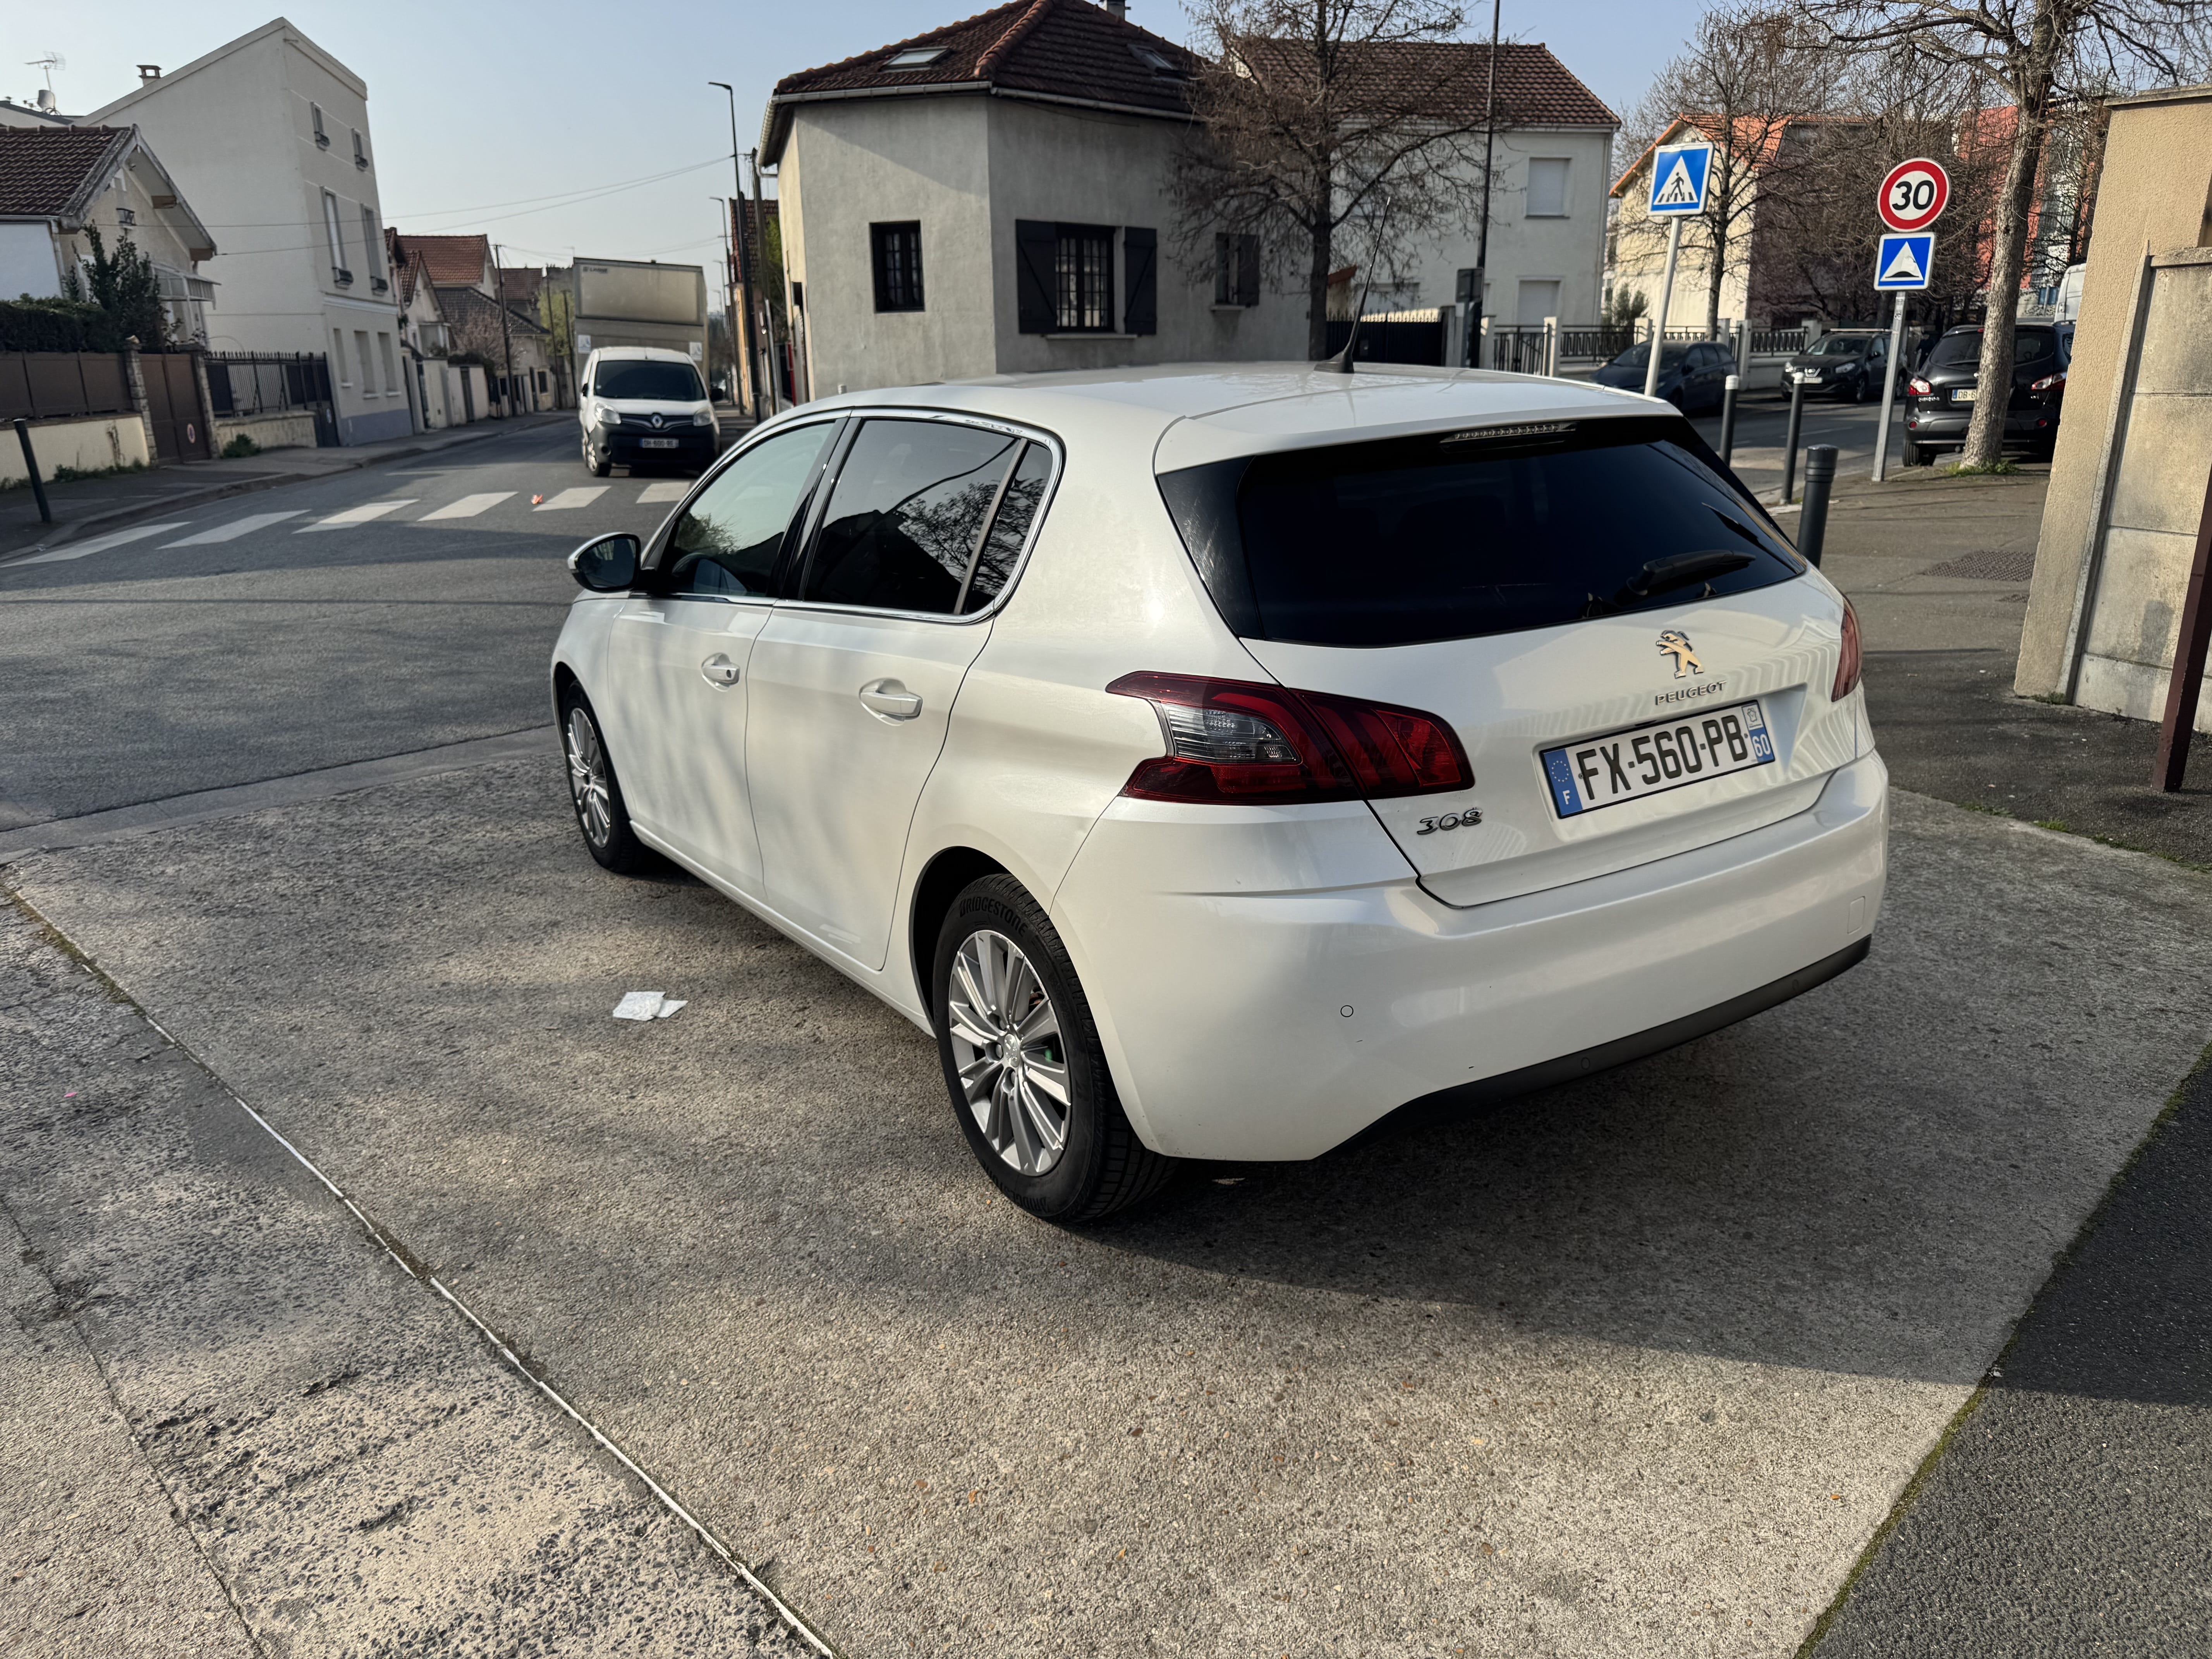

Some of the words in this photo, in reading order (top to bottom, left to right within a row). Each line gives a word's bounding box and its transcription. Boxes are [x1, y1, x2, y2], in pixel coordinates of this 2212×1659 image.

[1892, 180, 1934, 210] 30
[1655, 680, 1728, 705] PEUGEOT
[1576, 715, 1748, 800] FX-560-PB
[1752, 734, 1771, 757] 60
[1563, 790, 1570, 805] F
[1417, 808, 1483, 835] 308
[960, 896, 1028, 937] BRIDGESTONE
